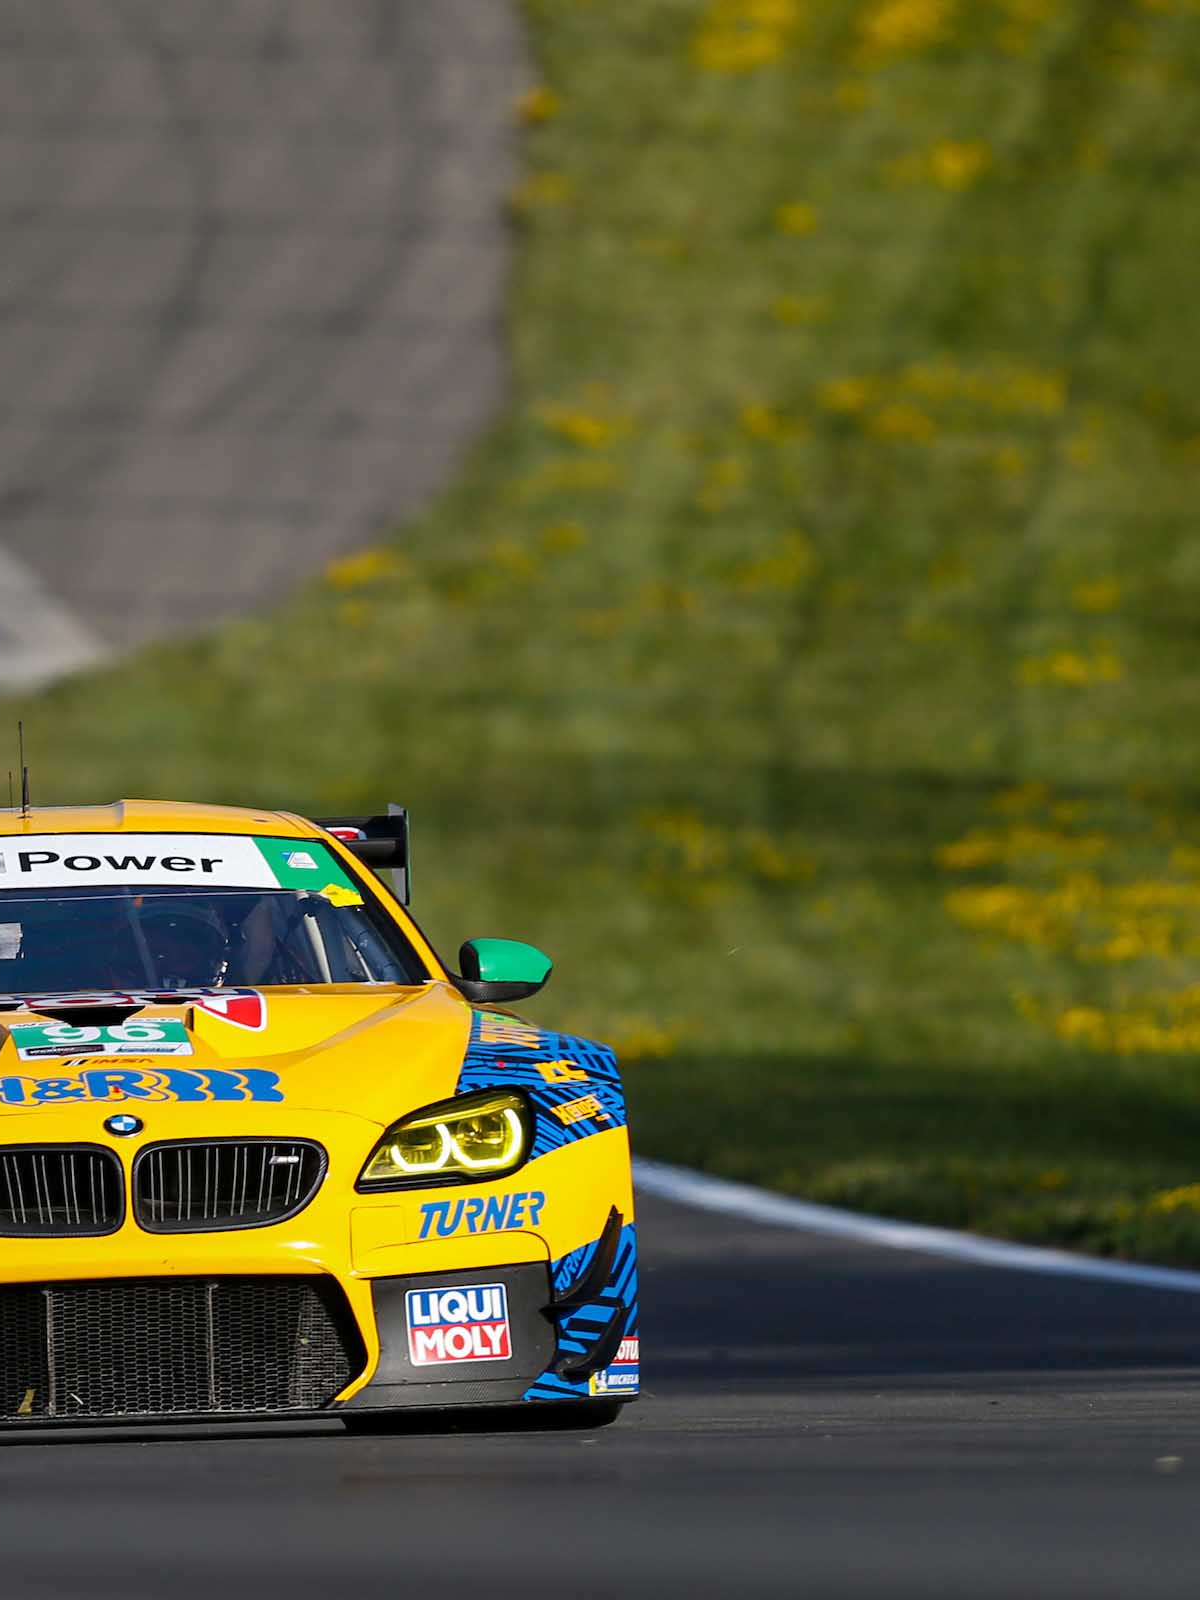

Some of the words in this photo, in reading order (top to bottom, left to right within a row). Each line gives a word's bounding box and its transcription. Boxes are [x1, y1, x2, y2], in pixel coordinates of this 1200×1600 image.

[18, 851, 224, 873] Power
[42, 1022, 167, 1043] 96
[419, 1191, 545, 1239] TURNER
[411, 1287, 503, 1326] LIQUI
[414, 1324, 507, 1361] MOLY
